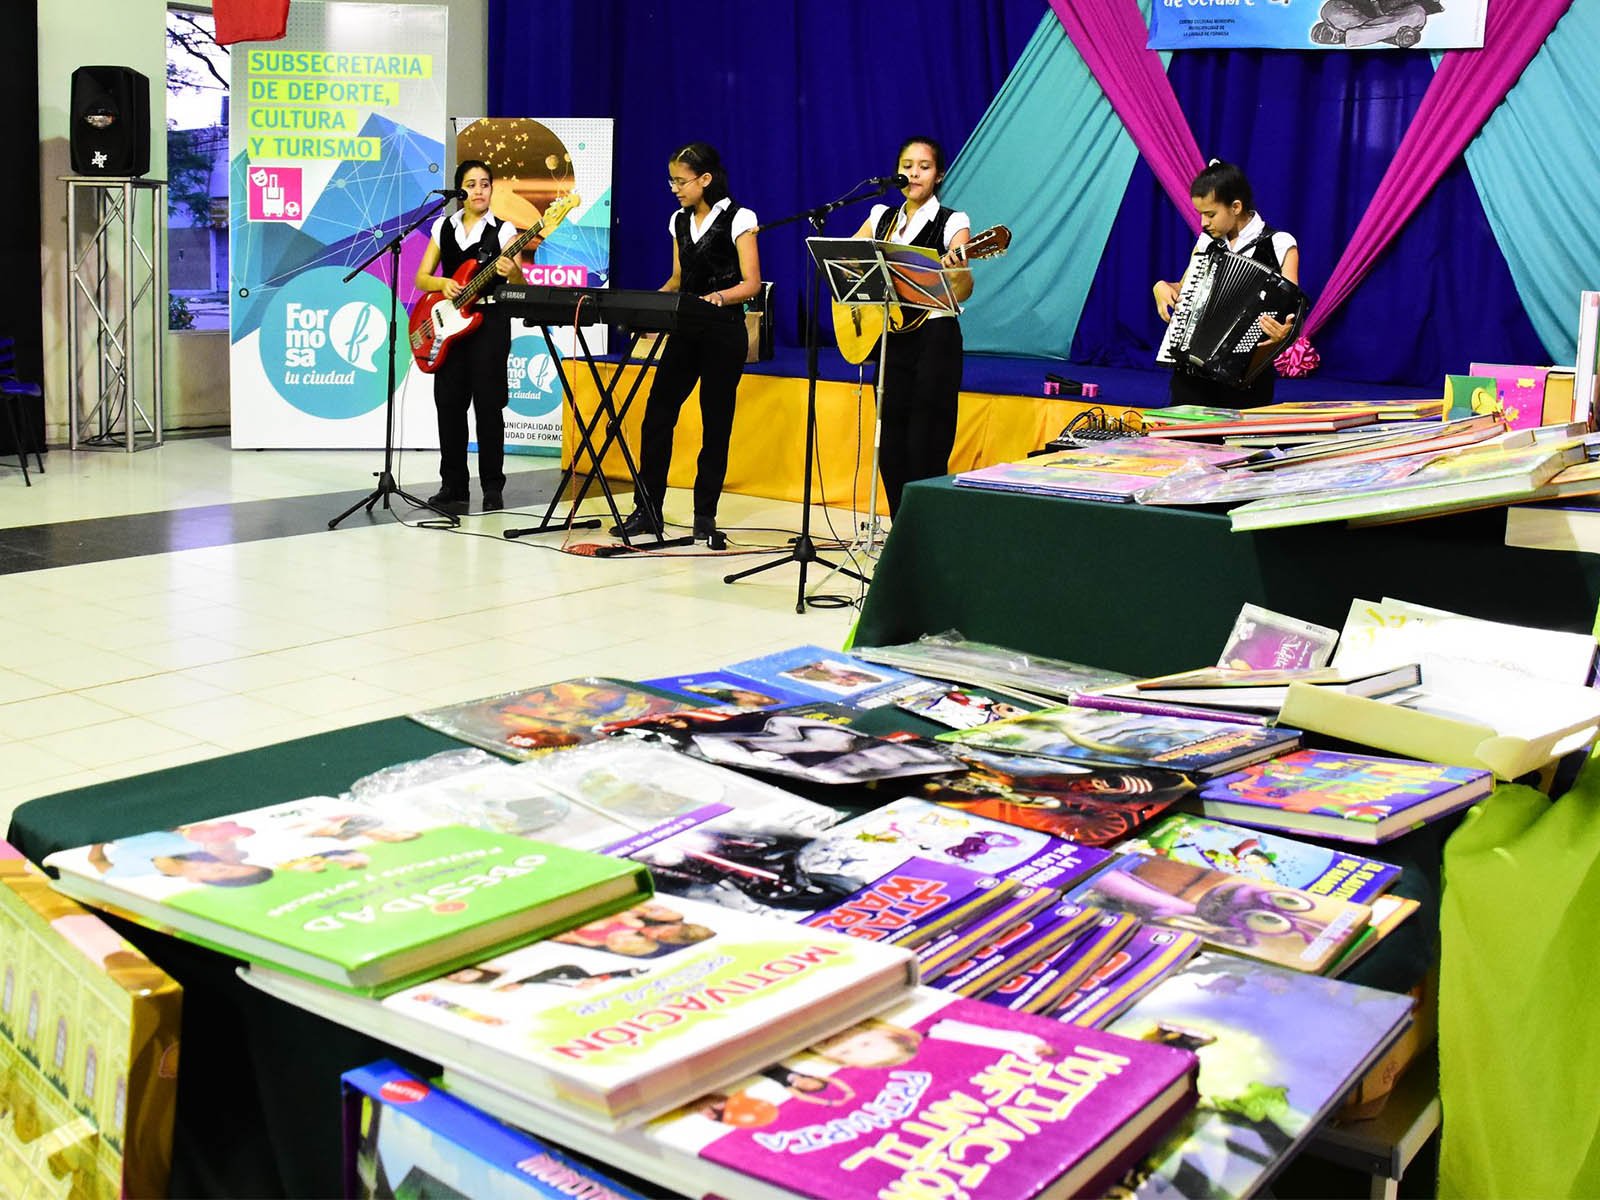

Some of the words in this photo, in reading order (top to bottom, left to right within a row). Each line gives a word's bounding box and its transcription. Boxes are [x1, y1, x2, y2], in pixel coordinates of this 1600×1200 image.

[251, 52, 423, 76] SUBSECRETARIA
[251, 81, 278, 100] DE
[288, 82, 391, 106] DEPORTE,
[251, 109, 346, 129] CULTURA
[251, 137, 264, 156] Y
[273, 137, 373, 158] TURISMO
[286, 303, 329, 329] For
[285, 329, 326, 349] mo
[285, 348, 316, 368] sa
[284, 371, 300, 385] tu
[302, 370, 356, 385] ciudad
[513, 390, 541, 399] ciudad
[526, 432, 537, 440] DE
[303, 854, 547, 932] OBESIDAD
[807, 875, 932, 929] WAR
[551, 945, 840, 1059] MOTIVACIÓN
[752, 1070, 932, 1154] PRIMARIA
